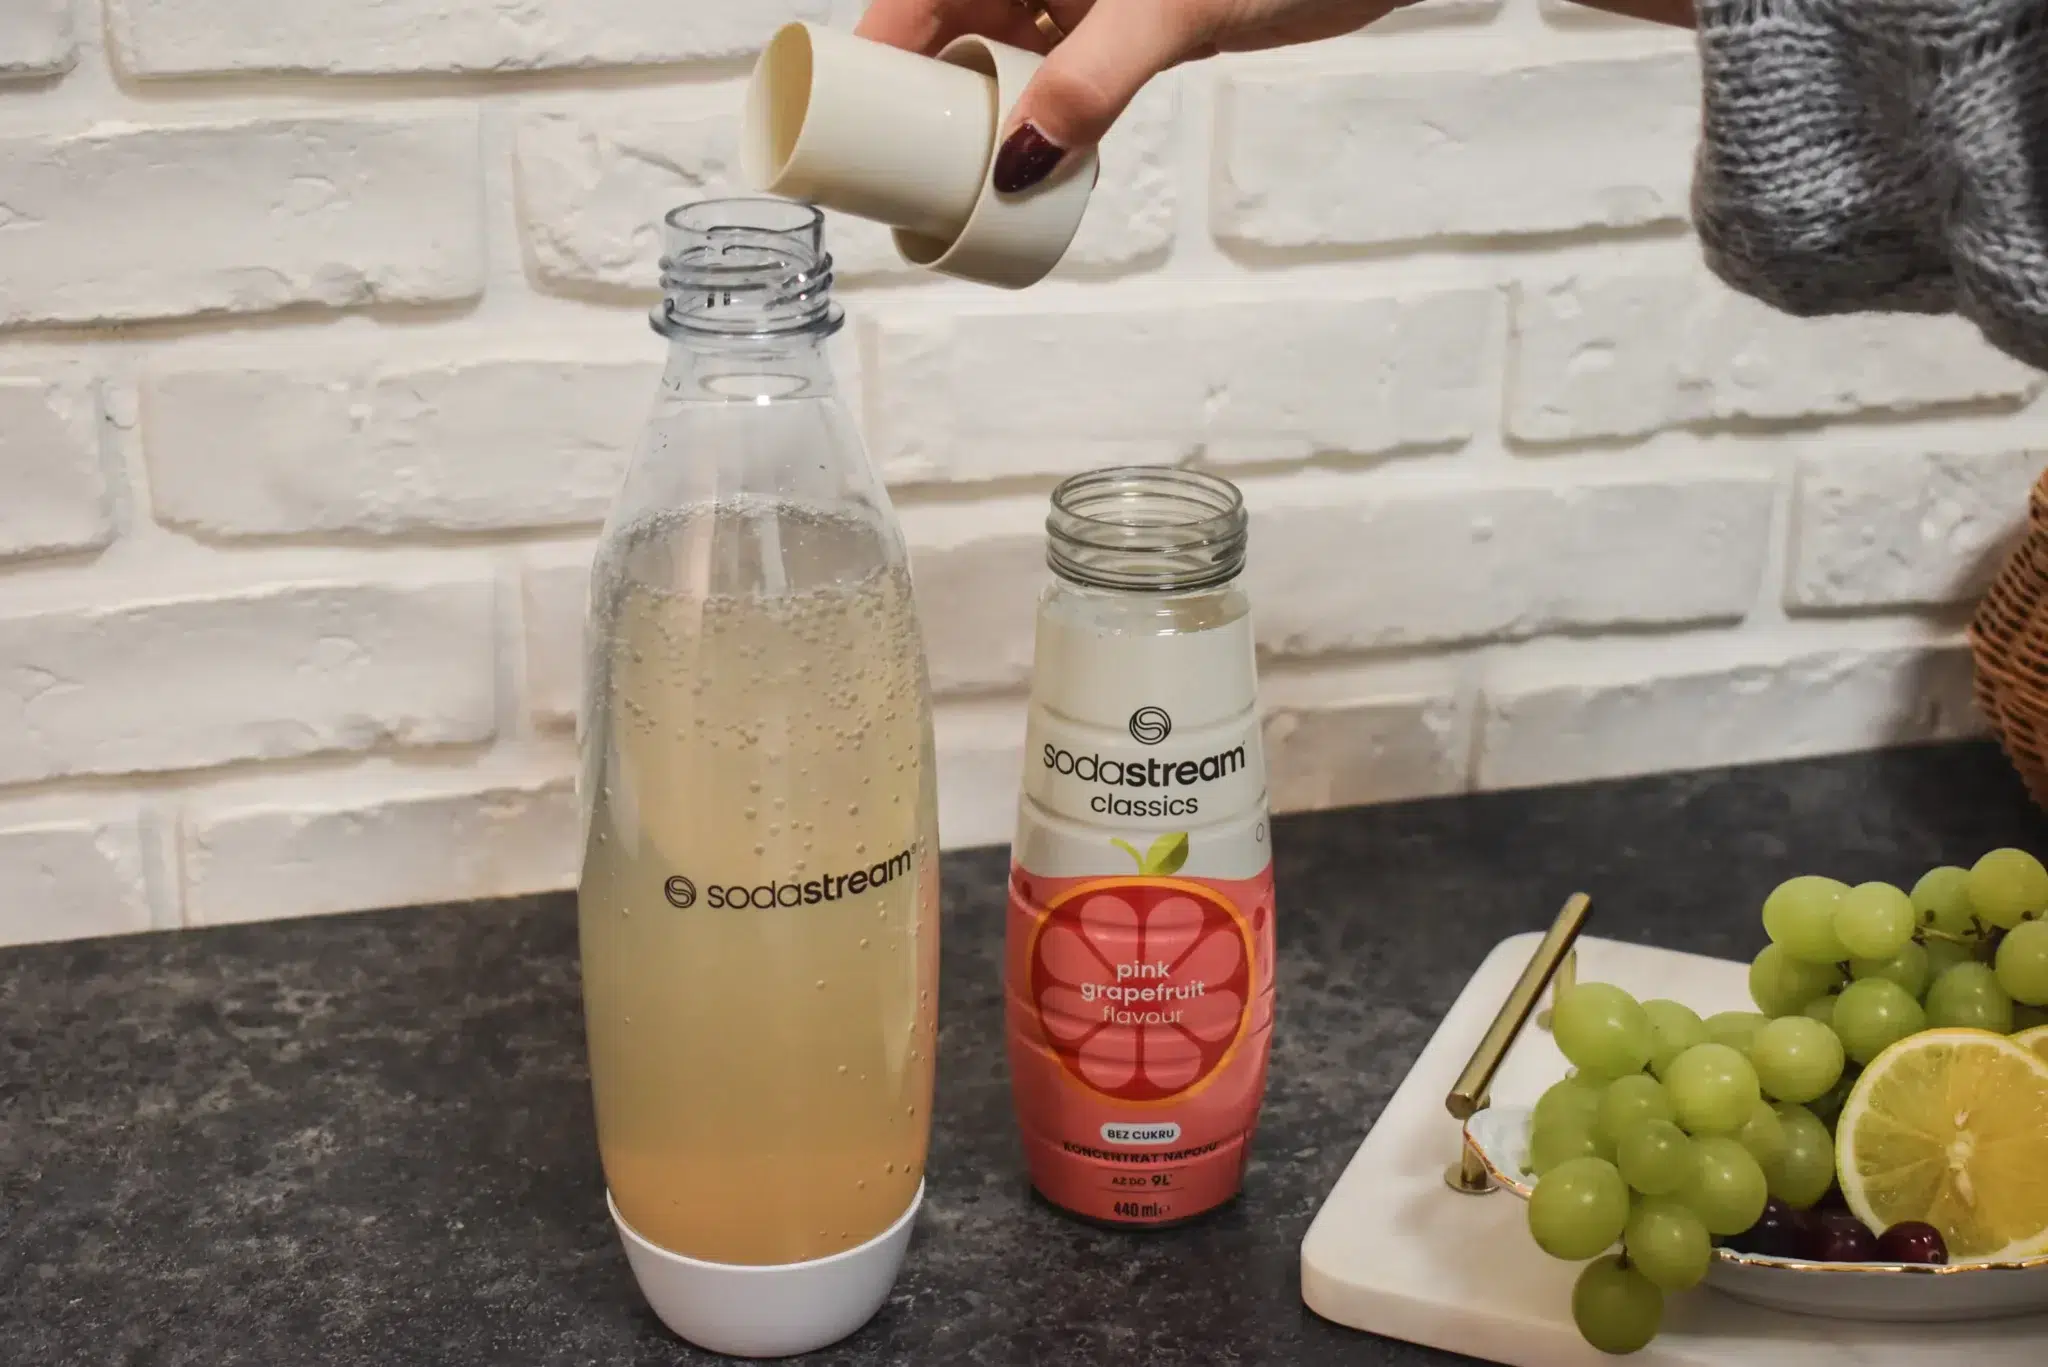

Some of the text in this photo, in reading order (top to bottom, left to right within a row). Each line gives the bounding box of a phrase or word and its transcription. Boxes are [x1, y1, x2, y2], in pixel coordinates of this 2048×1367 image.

[1043, 743, 1246, 787] sodastream
[1090, 793, 1199, 817] classics
[707, 849, 912, 909] sodastream
[1117, 960, 1171, 982] pink
[1080, 980, 1205, 1006] grapefruit
[1102, 1005, 1184, 1024] flavour
[1107, 1128, 1175, 1140] BEZ CUKRU
[1129, 1176, 1146, 1186] DO
[1113, 1201, 1139, 1218] 440
